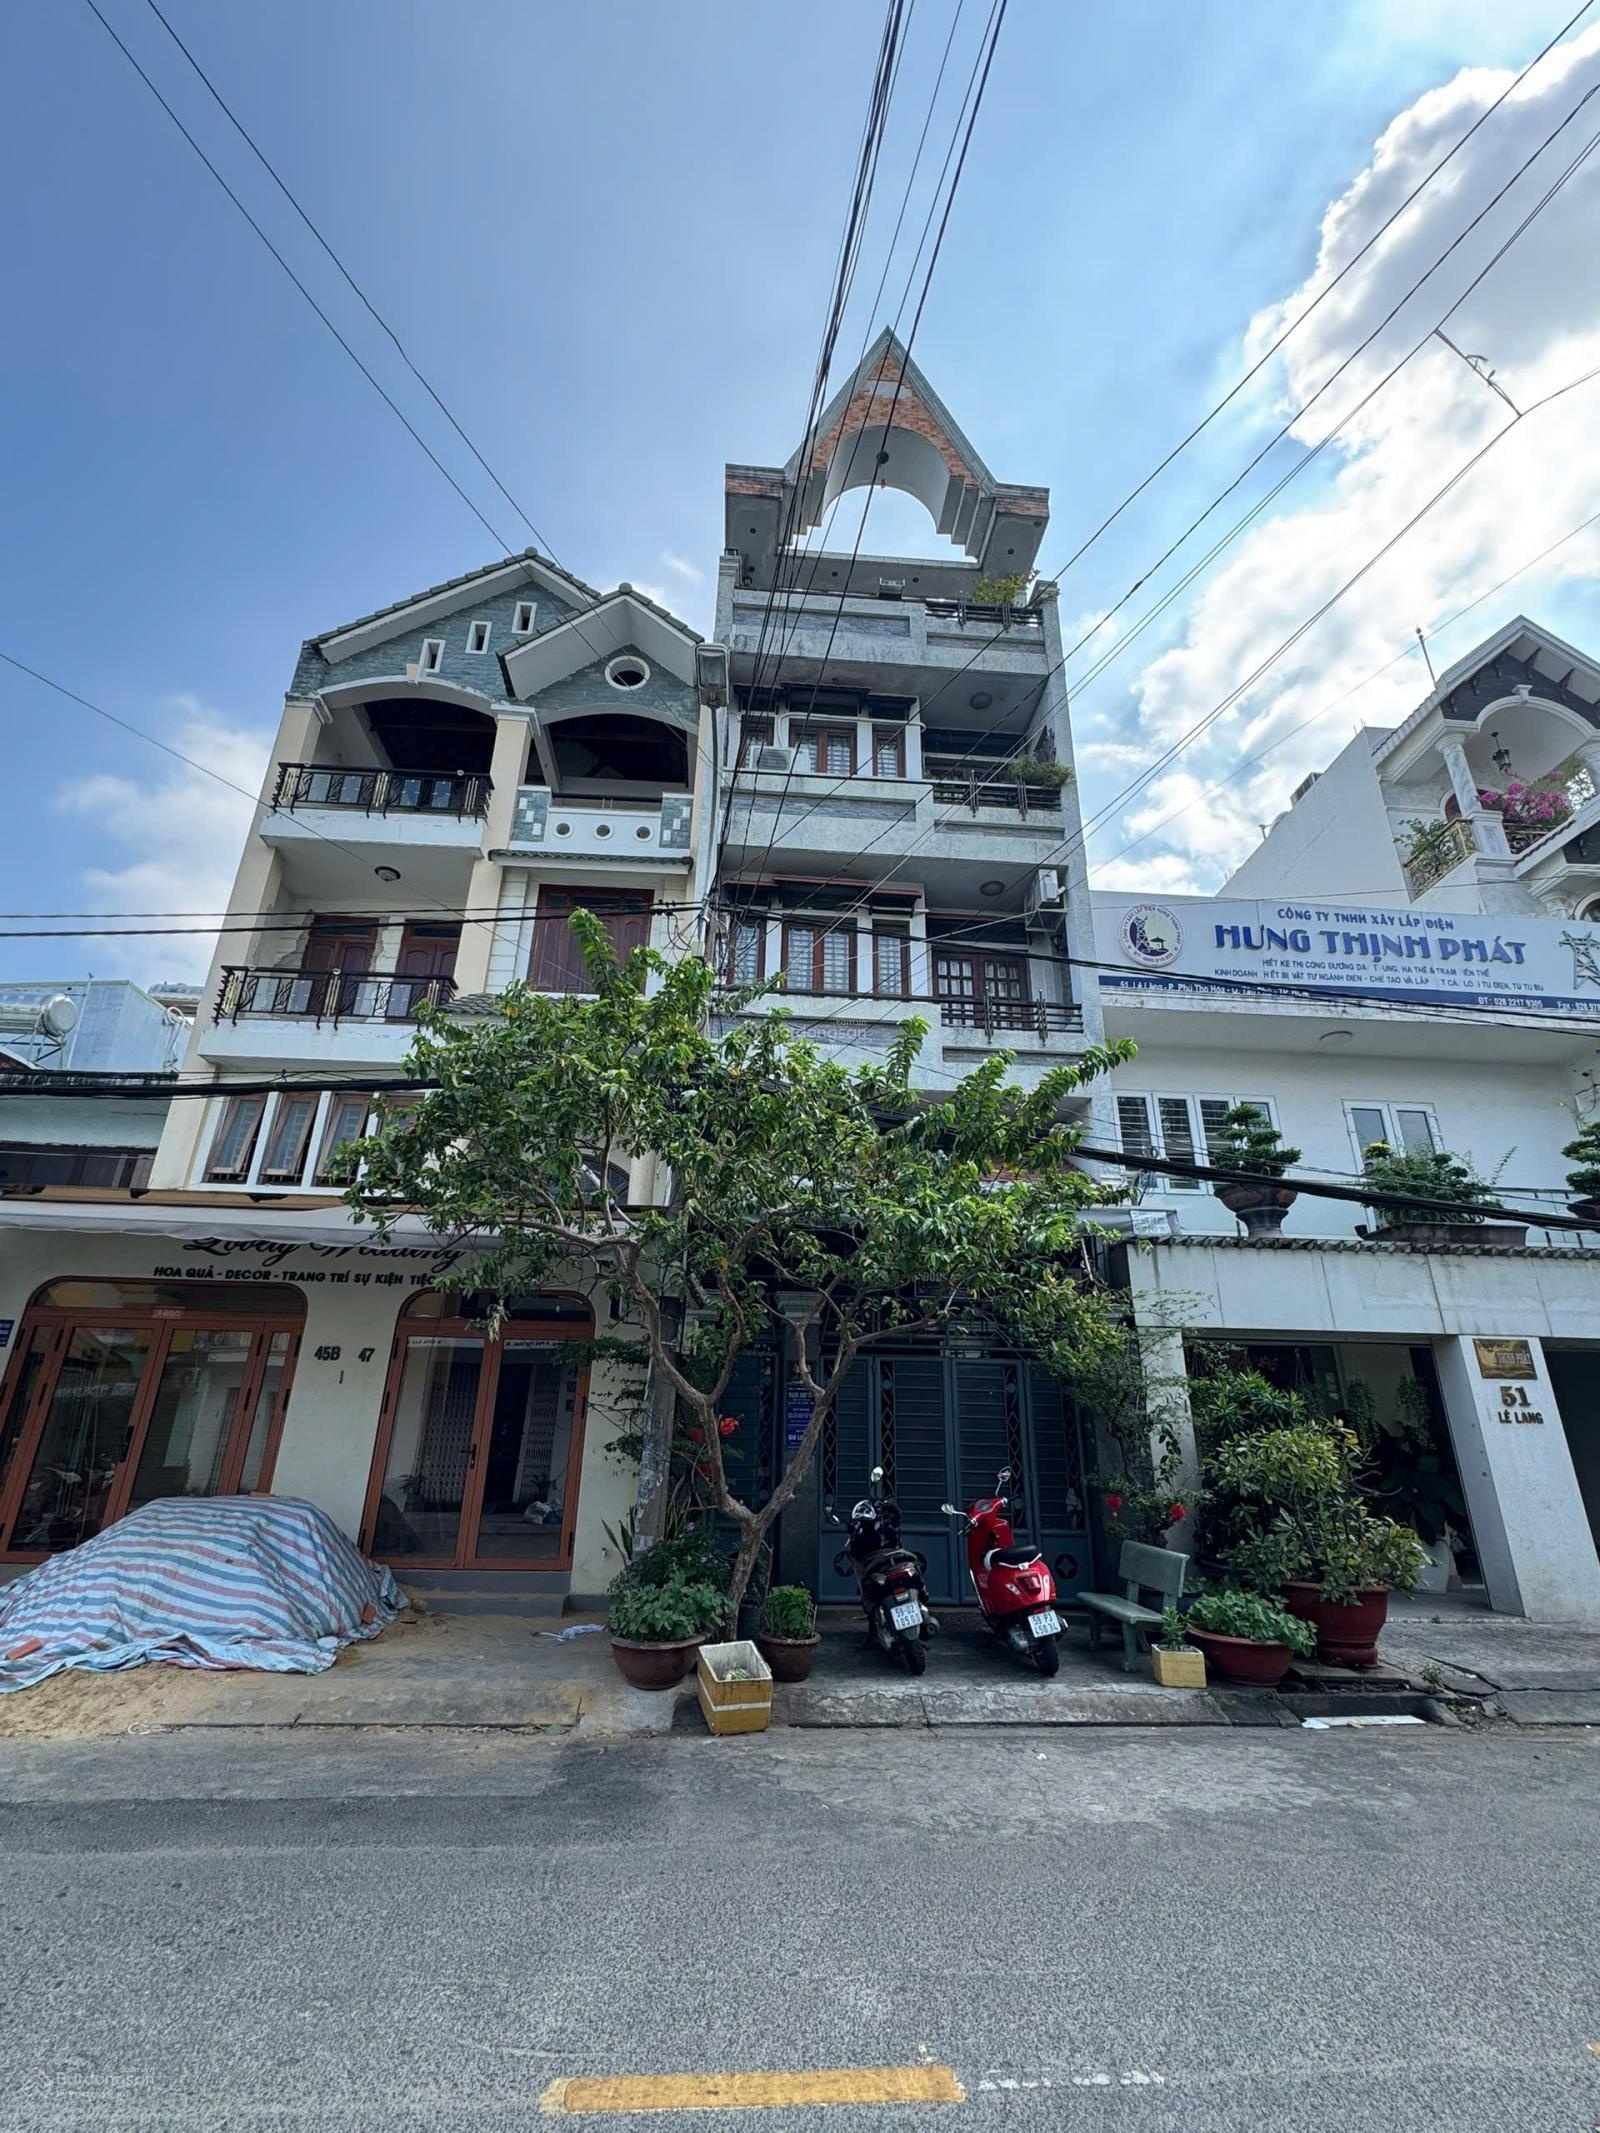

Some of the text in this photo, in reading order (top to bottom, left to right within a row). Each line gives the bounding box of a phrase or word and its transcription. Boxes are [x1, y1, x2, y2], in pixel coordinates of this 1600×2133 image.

[1277, 906, 1312, 921] CÔNG
[1315, 911, 1330, 922] TY
[1334, 912, 1367, 925] TNHH
[1370, 913, 1396, 926] XÂY
[1425, 917, 1455, 932] ĐIỆN
[1214, 923, 1528, 964] HƯNG THỊNH PHÁT
[152, 1266, 182, 1278] HOA
[185, 1264, 214, 1279] QUẢ
[225, 1269, 271, 1281] DECOR
[282, 1271, 326, 1283] TRANG
[329, 1270, 351, 1283] TRÍ
[353, 1272, 372, 1286] SỰ
[375, 1272, 404, 1287] KIỆN
[314, 1345, 375, 1362] 45B 47
[1500, 1386, 1532, 1407] 51
[1497, 1409, 1512, 1424] LÊ
